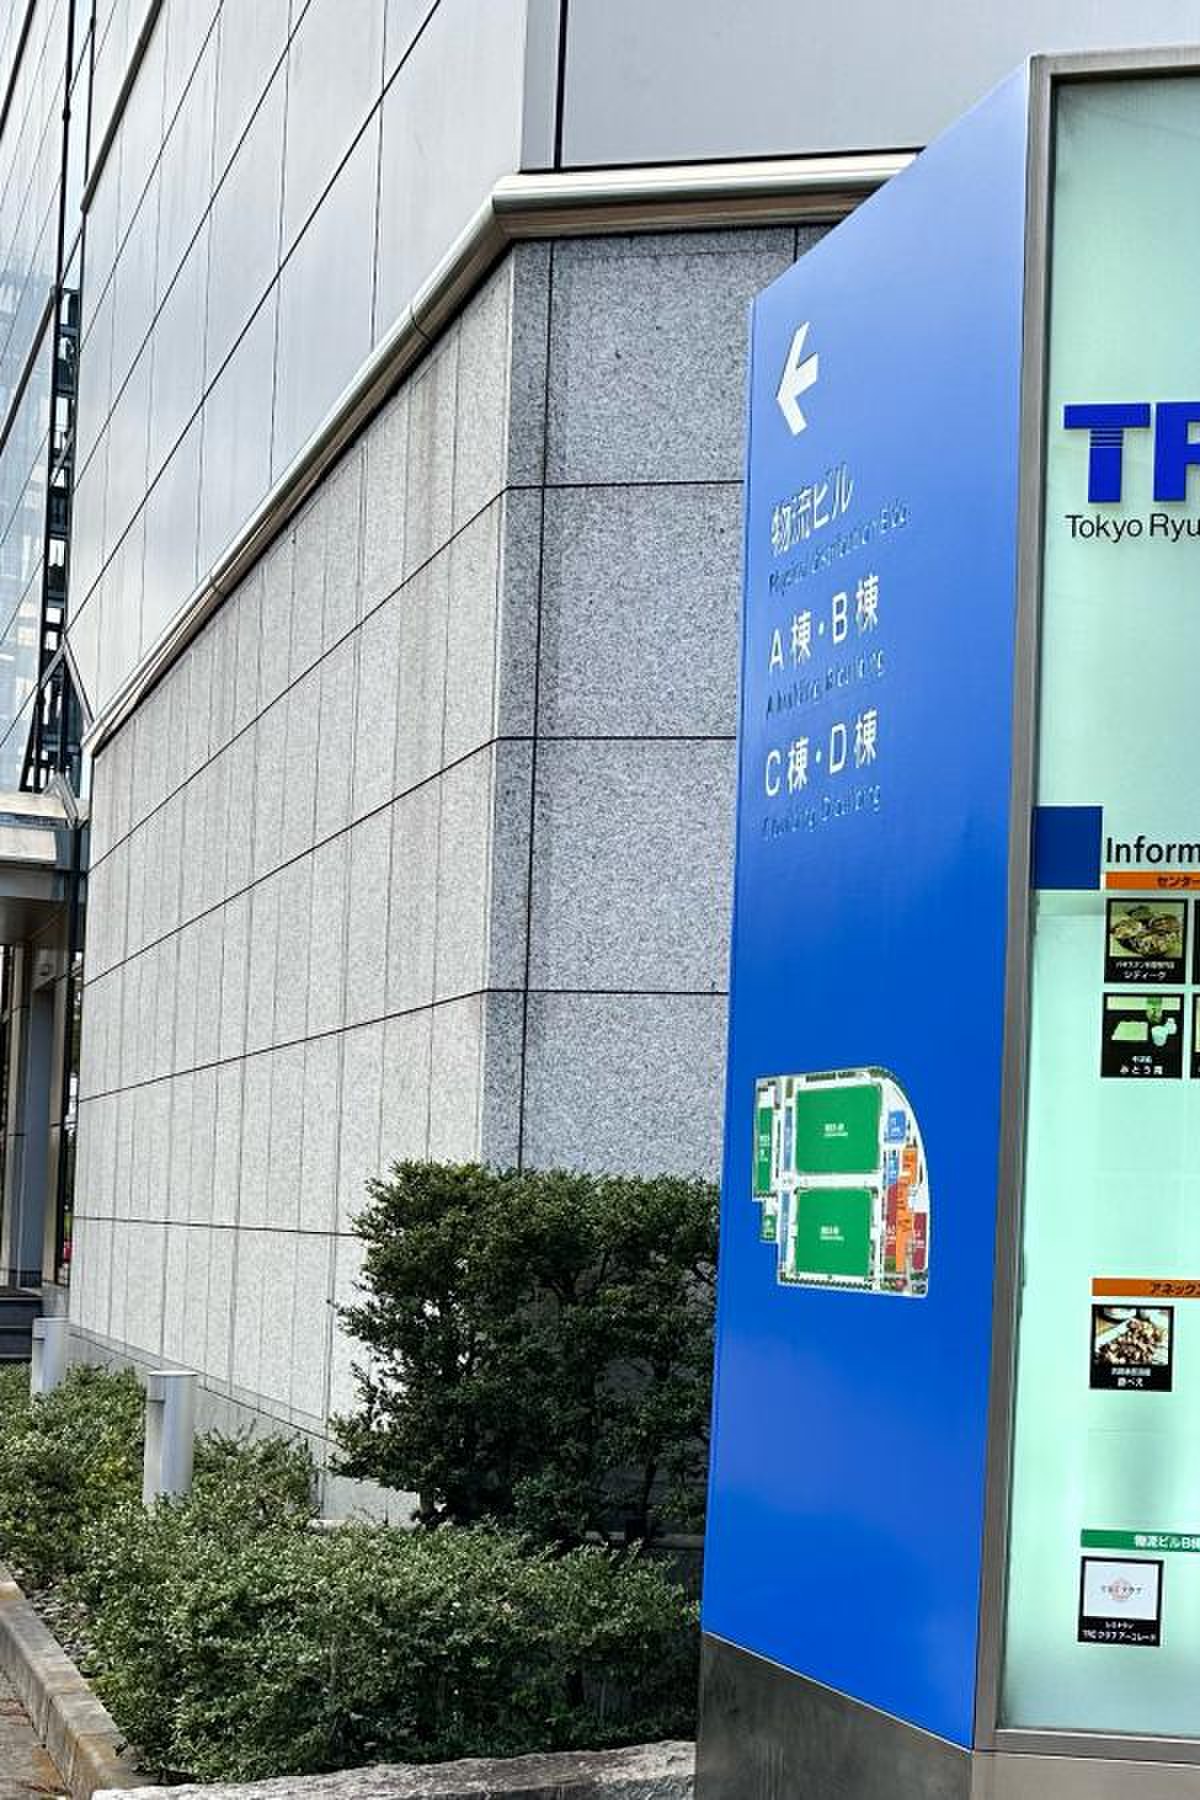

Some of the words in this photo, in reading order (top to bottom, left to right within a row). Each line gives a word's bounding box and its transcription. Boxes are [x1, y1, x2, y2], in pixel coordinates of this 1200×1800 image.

[770, 463, 854, 556] 物流ビル
[1065, 514, 1143, 543] Tokyo
